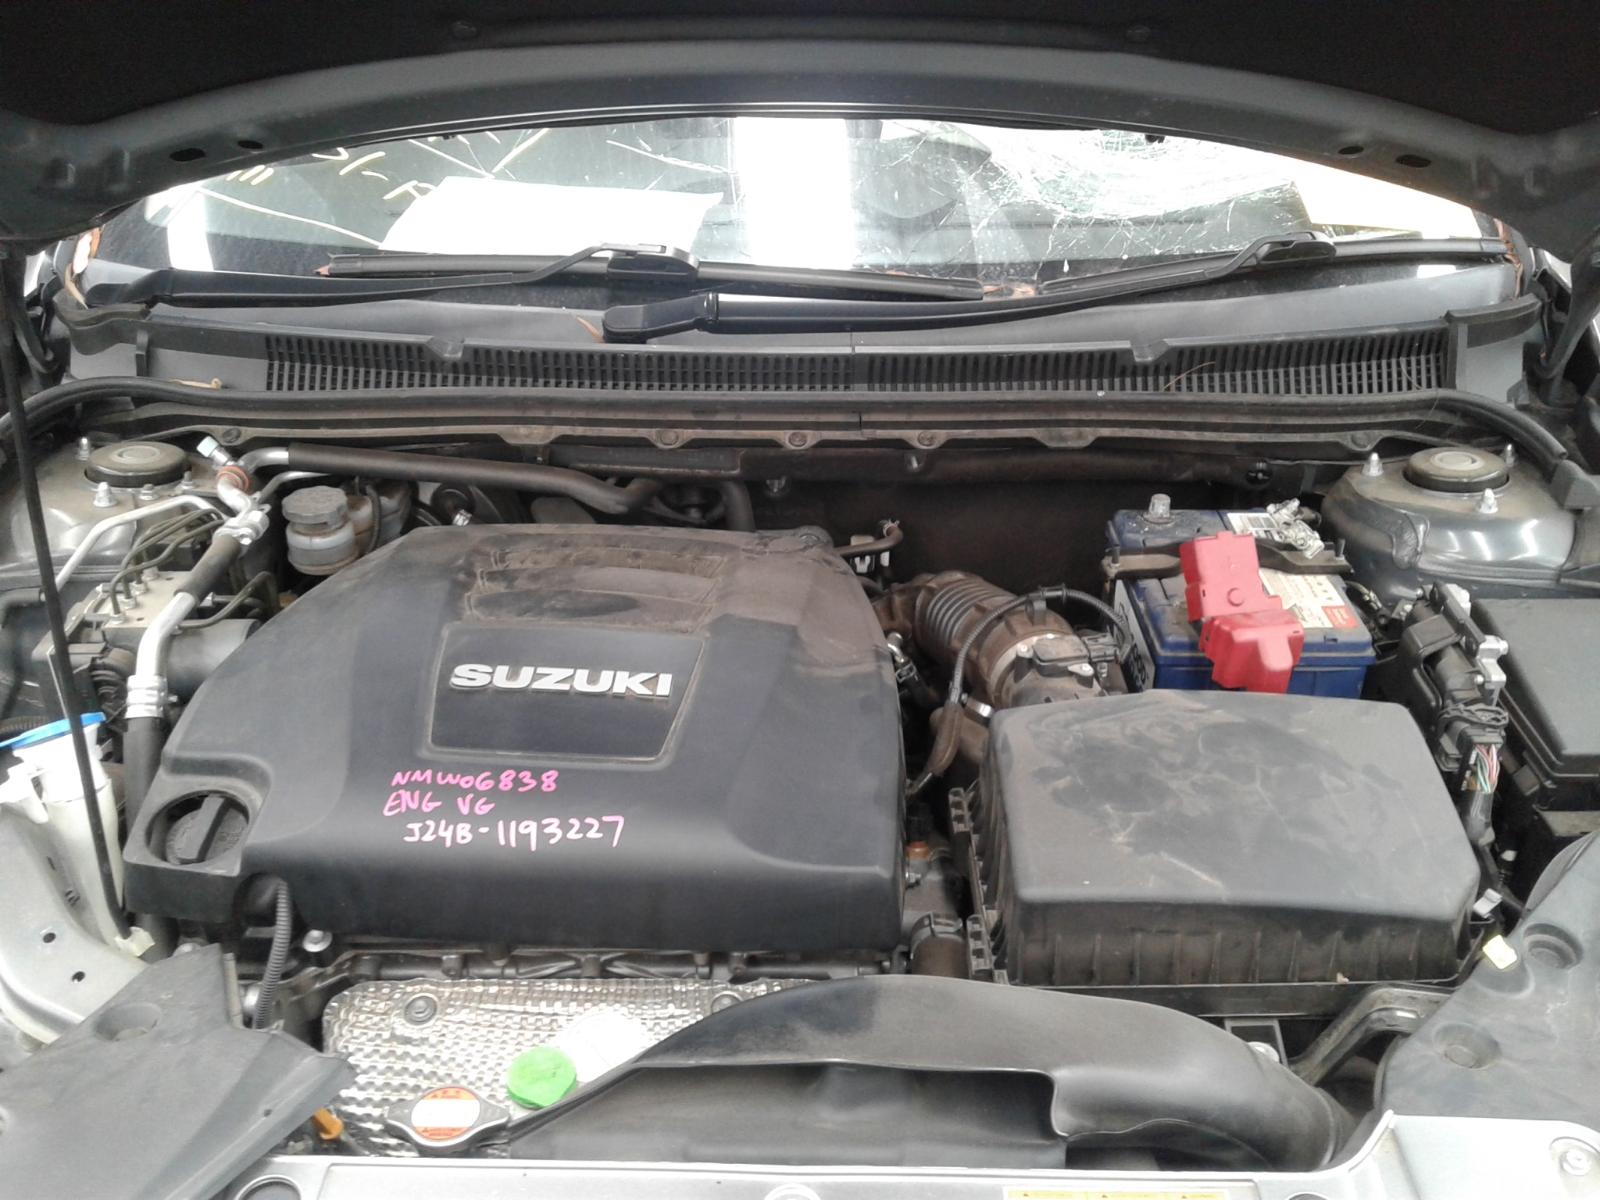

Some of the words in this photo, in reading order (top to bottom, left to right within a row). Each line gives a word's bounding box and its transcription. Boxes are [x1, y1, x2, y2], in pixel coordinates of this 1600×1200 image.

[451, 664, 673, 697] SUZUKI
[383, 789, 443, 816] ENG
[403, 816, 625, 851] J24B-1193227
